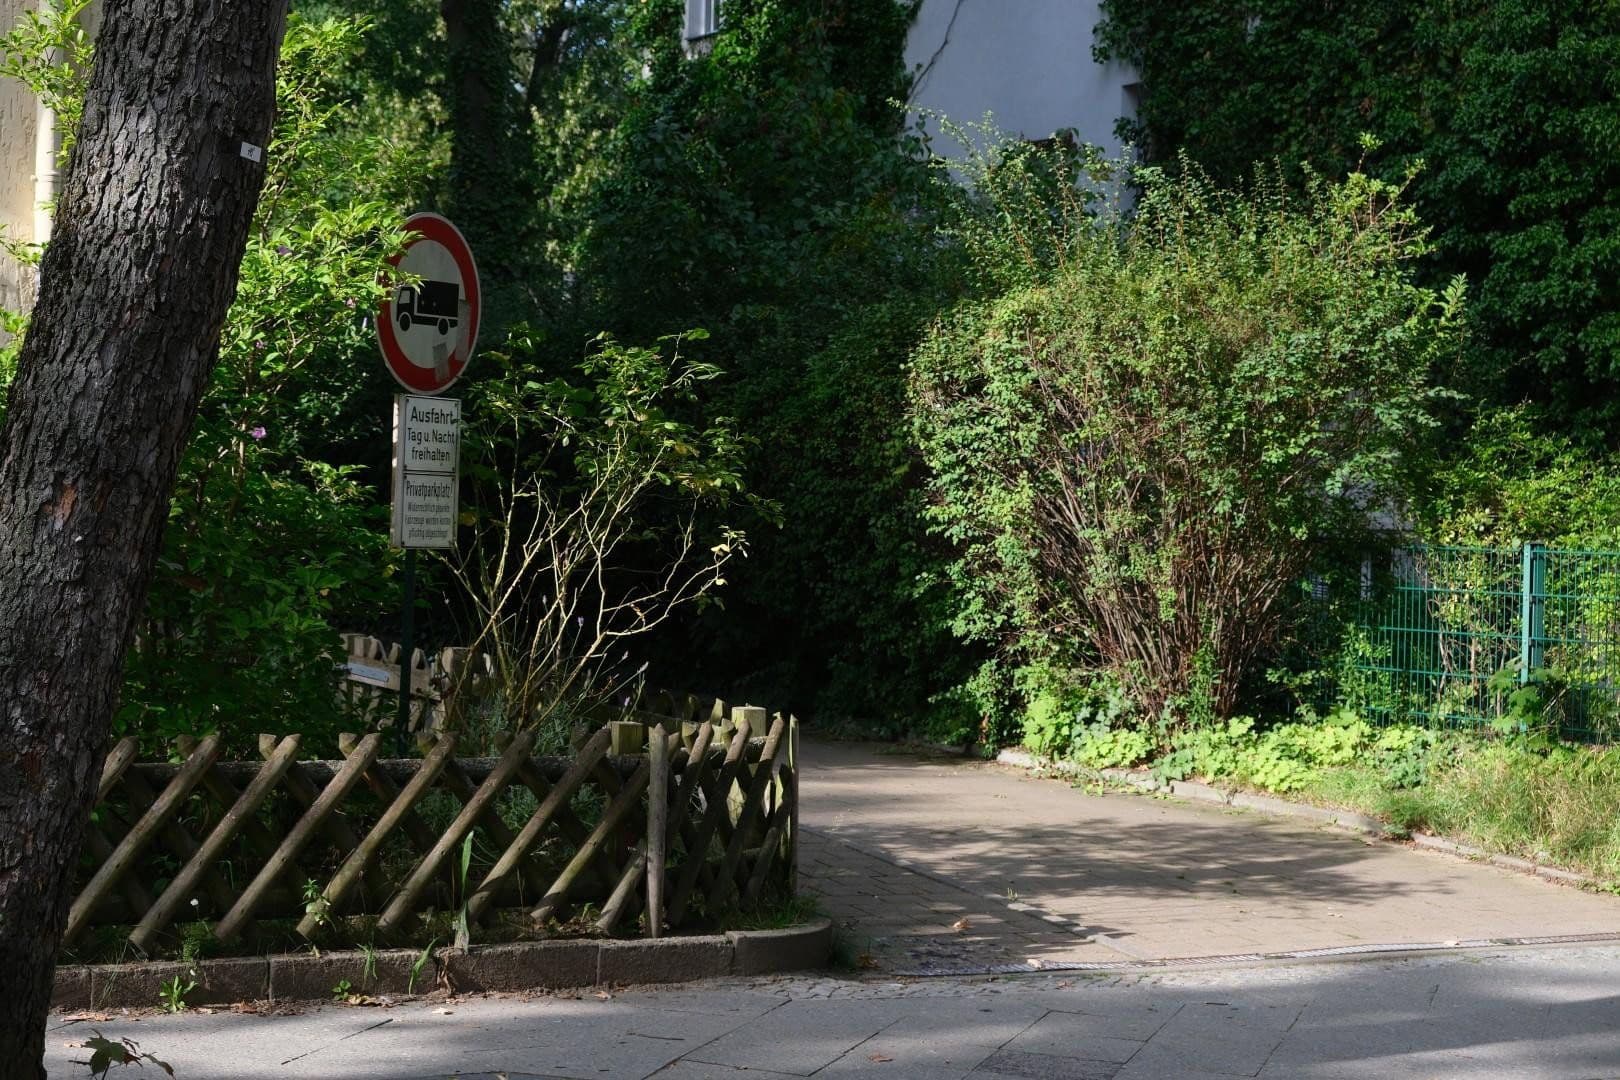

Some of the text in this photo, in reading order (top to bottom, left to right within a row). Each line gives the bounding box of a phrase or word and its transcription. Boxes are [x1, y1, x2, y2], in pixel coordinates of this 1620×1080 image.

[410, 406, 454, 424] Ausfahrt
[408, 428, 454, 446] Tag u. Nacht
[412, 447, 450, 461] freihalten
